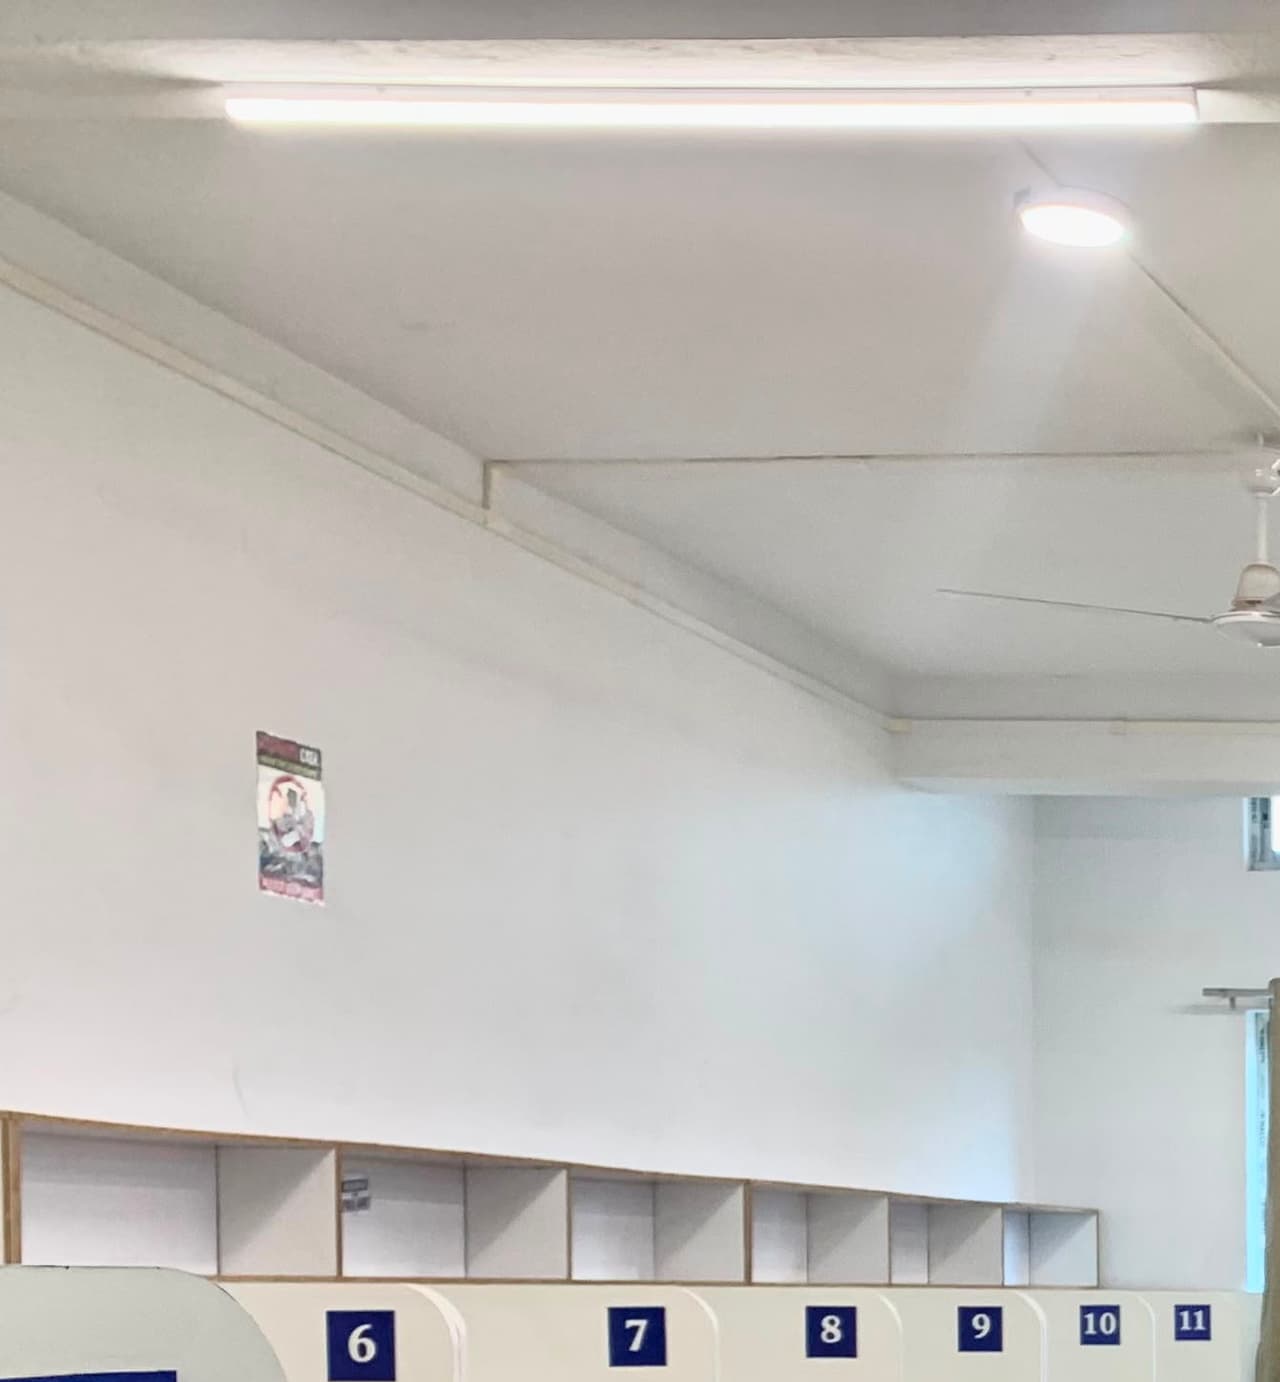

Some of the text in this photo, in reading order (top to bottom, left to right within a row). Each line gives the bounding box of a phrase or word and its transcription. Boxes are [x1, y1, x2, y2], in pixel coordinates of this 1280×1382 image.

[820, 1315, 842, 1343] 8
[972, 1313, 991, 1340] 9
[1083, 1312, 1116, 1335] 10
[1180, 1310, 1206, 1332] 11
[347, 1324, 376, 1363] 6
[624, 1319, 648, 1352] 7
